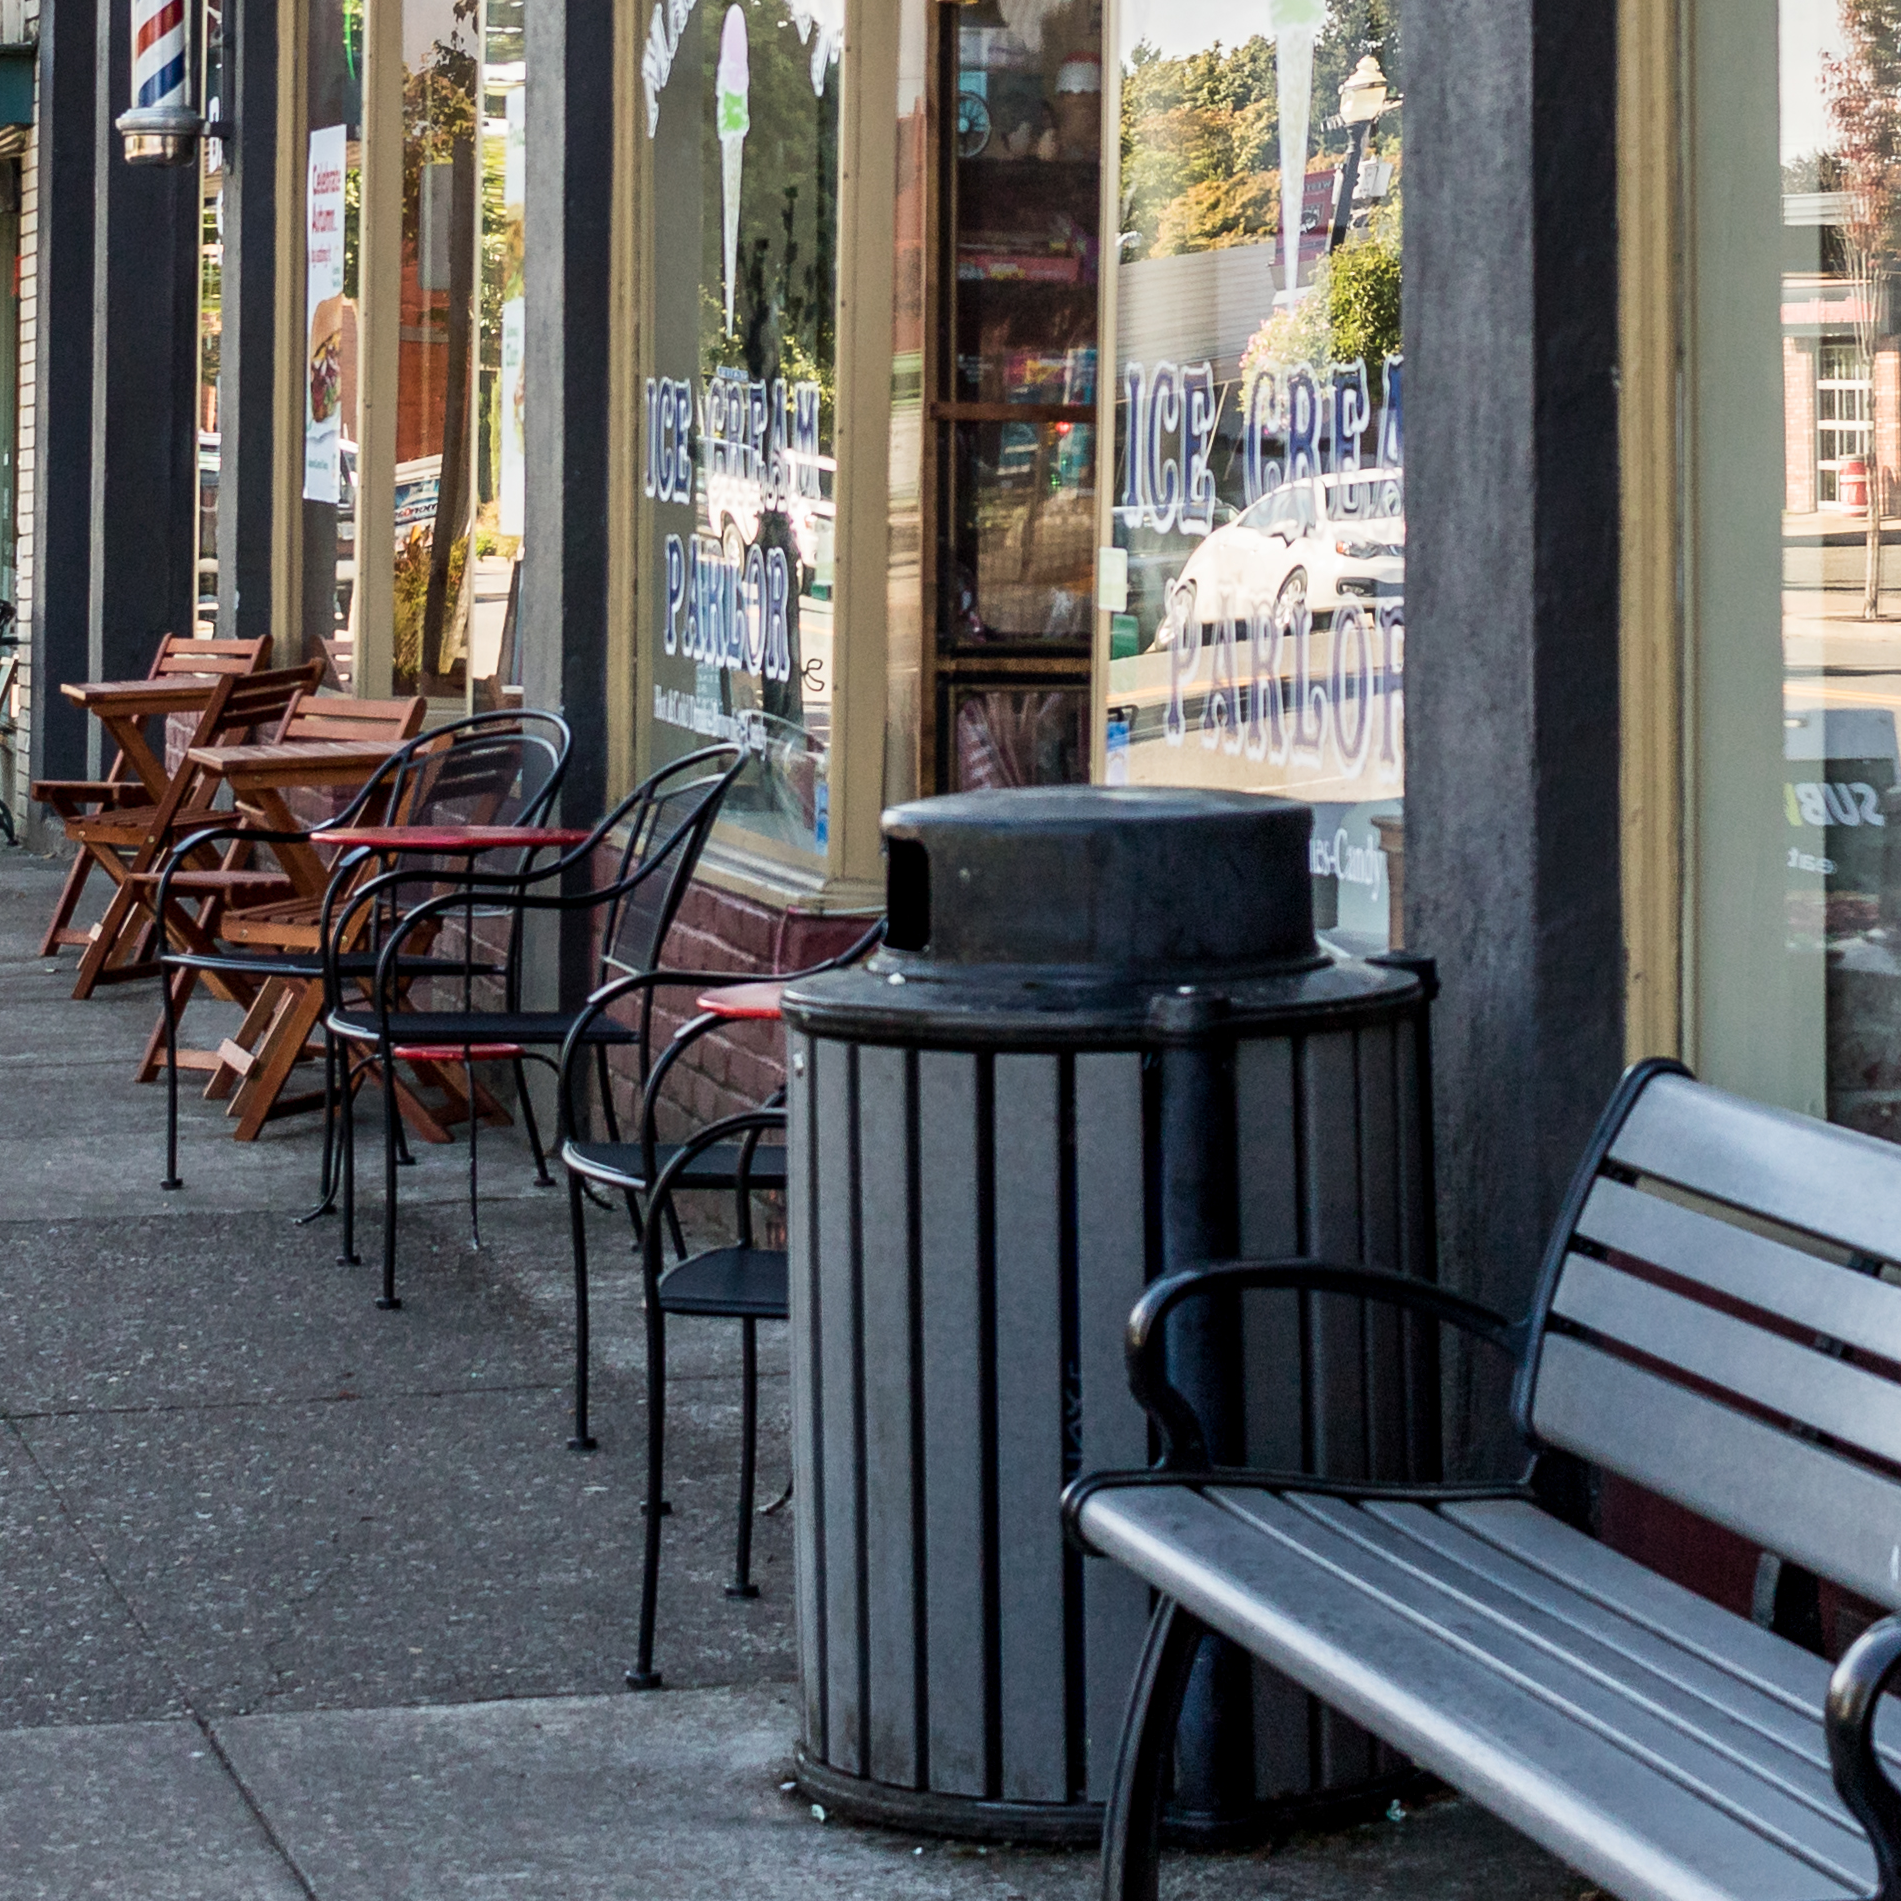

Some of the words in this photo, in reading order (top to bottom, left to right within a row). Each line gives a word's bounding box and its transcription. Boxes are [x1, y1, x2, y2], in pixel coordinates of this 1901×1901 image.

[645, 377, 693, 506] ICE
[1123, 362, 1216, 536] ICE
[664, 533, 791, 683] PARLOR
